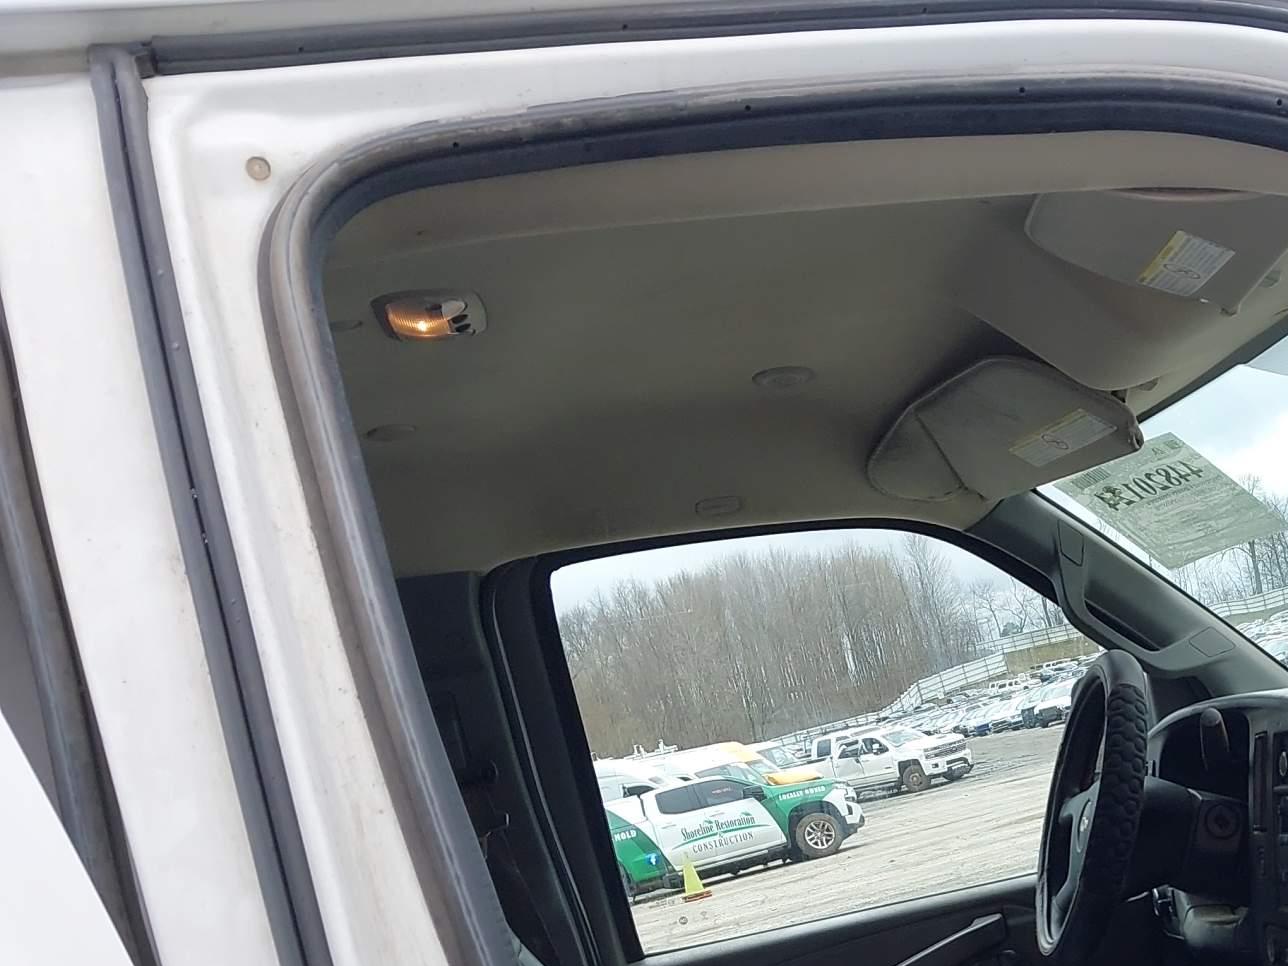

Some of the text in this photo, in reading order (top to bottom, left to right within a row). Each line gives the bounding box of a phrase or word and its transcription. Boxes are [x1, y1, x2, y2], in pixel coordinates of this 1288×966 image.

[614, 829, 637, 842] MOLD
[680, 816, 755, 841] Shoreline Restoration
[692, 831, 754, 854] CONSTRUCTION
